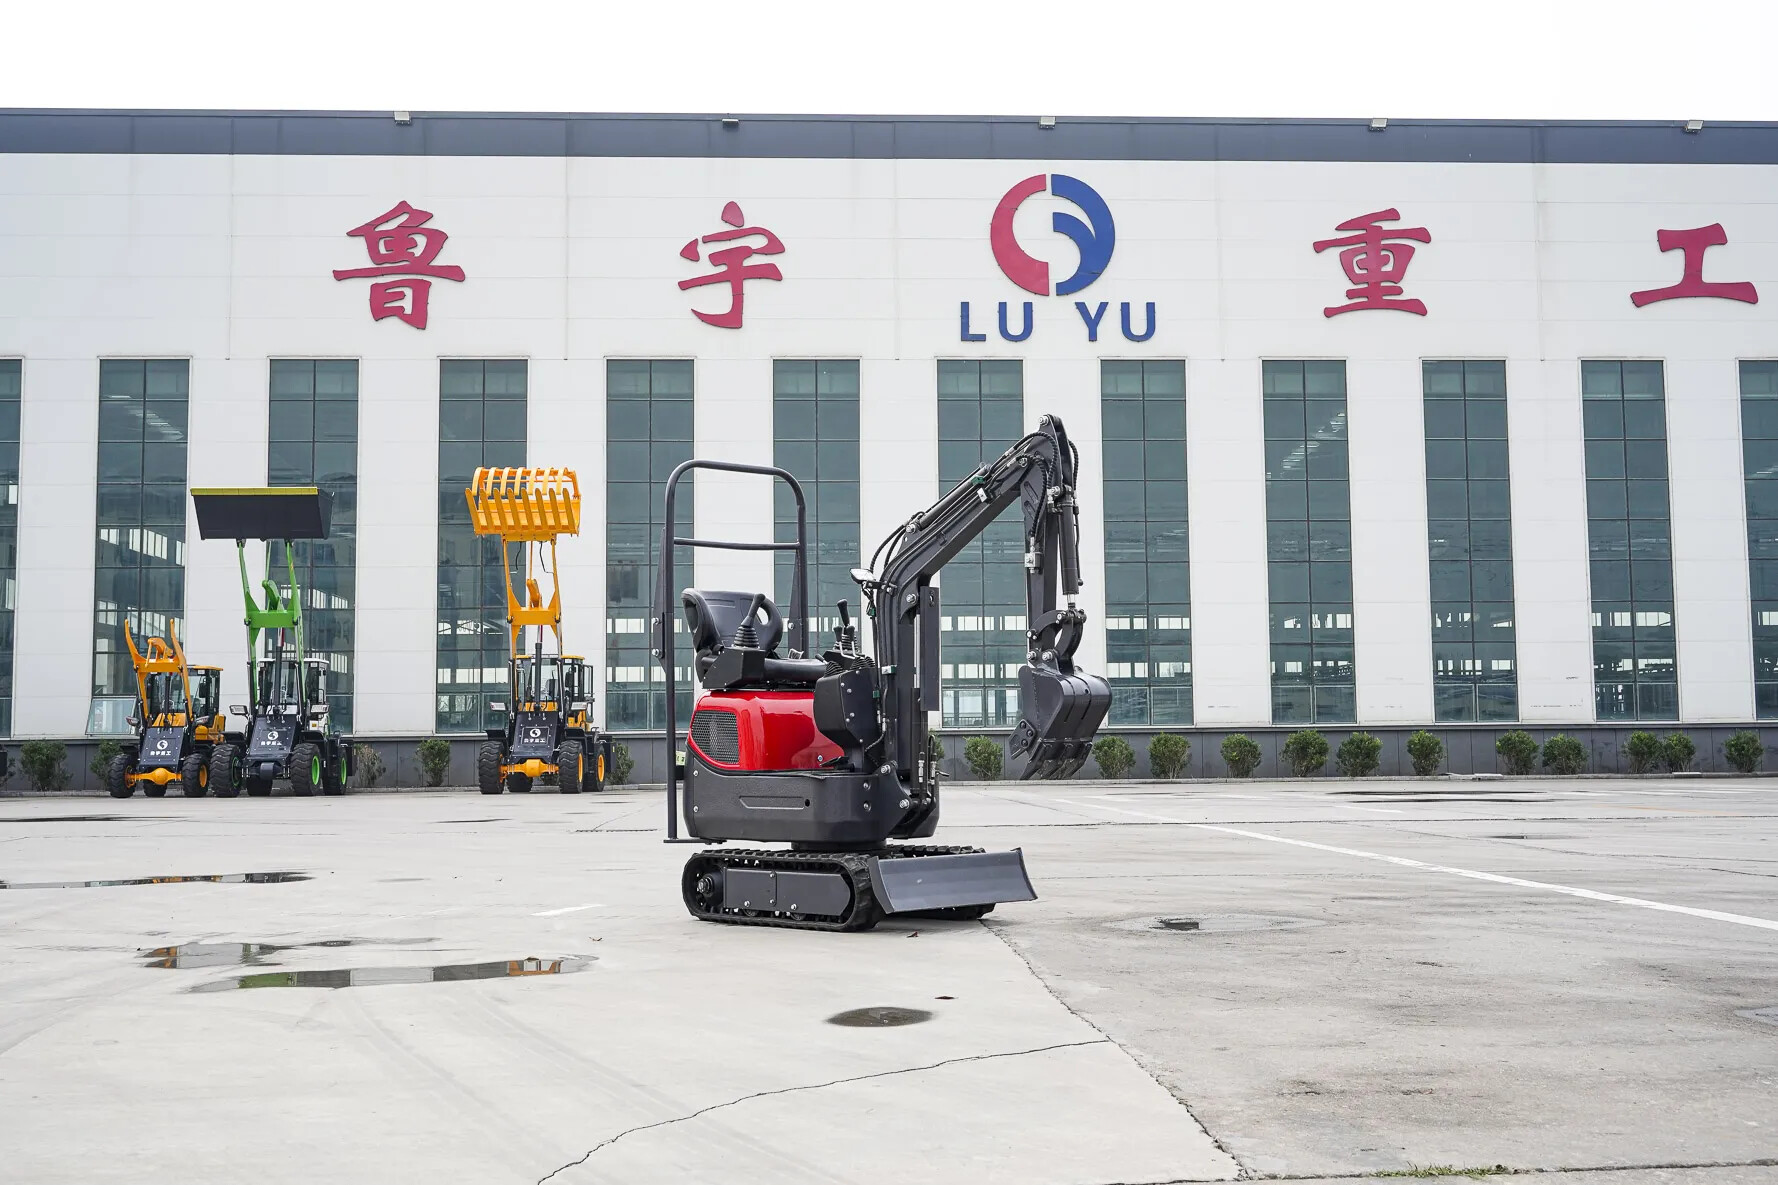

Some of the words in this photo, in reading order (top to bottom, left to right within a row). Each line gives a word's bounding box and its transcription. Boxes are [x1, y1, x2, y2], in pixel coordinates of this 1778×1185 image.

[332, 200, 466, 330] 鲁
[677, 201, 786, 329] 宇
[1312, 207, 1432, 318] 重
[1631, 222, 1757, 308] 工
[961, 301, 1033, 342] LU
[1074, 301, 1156, 342] YU
